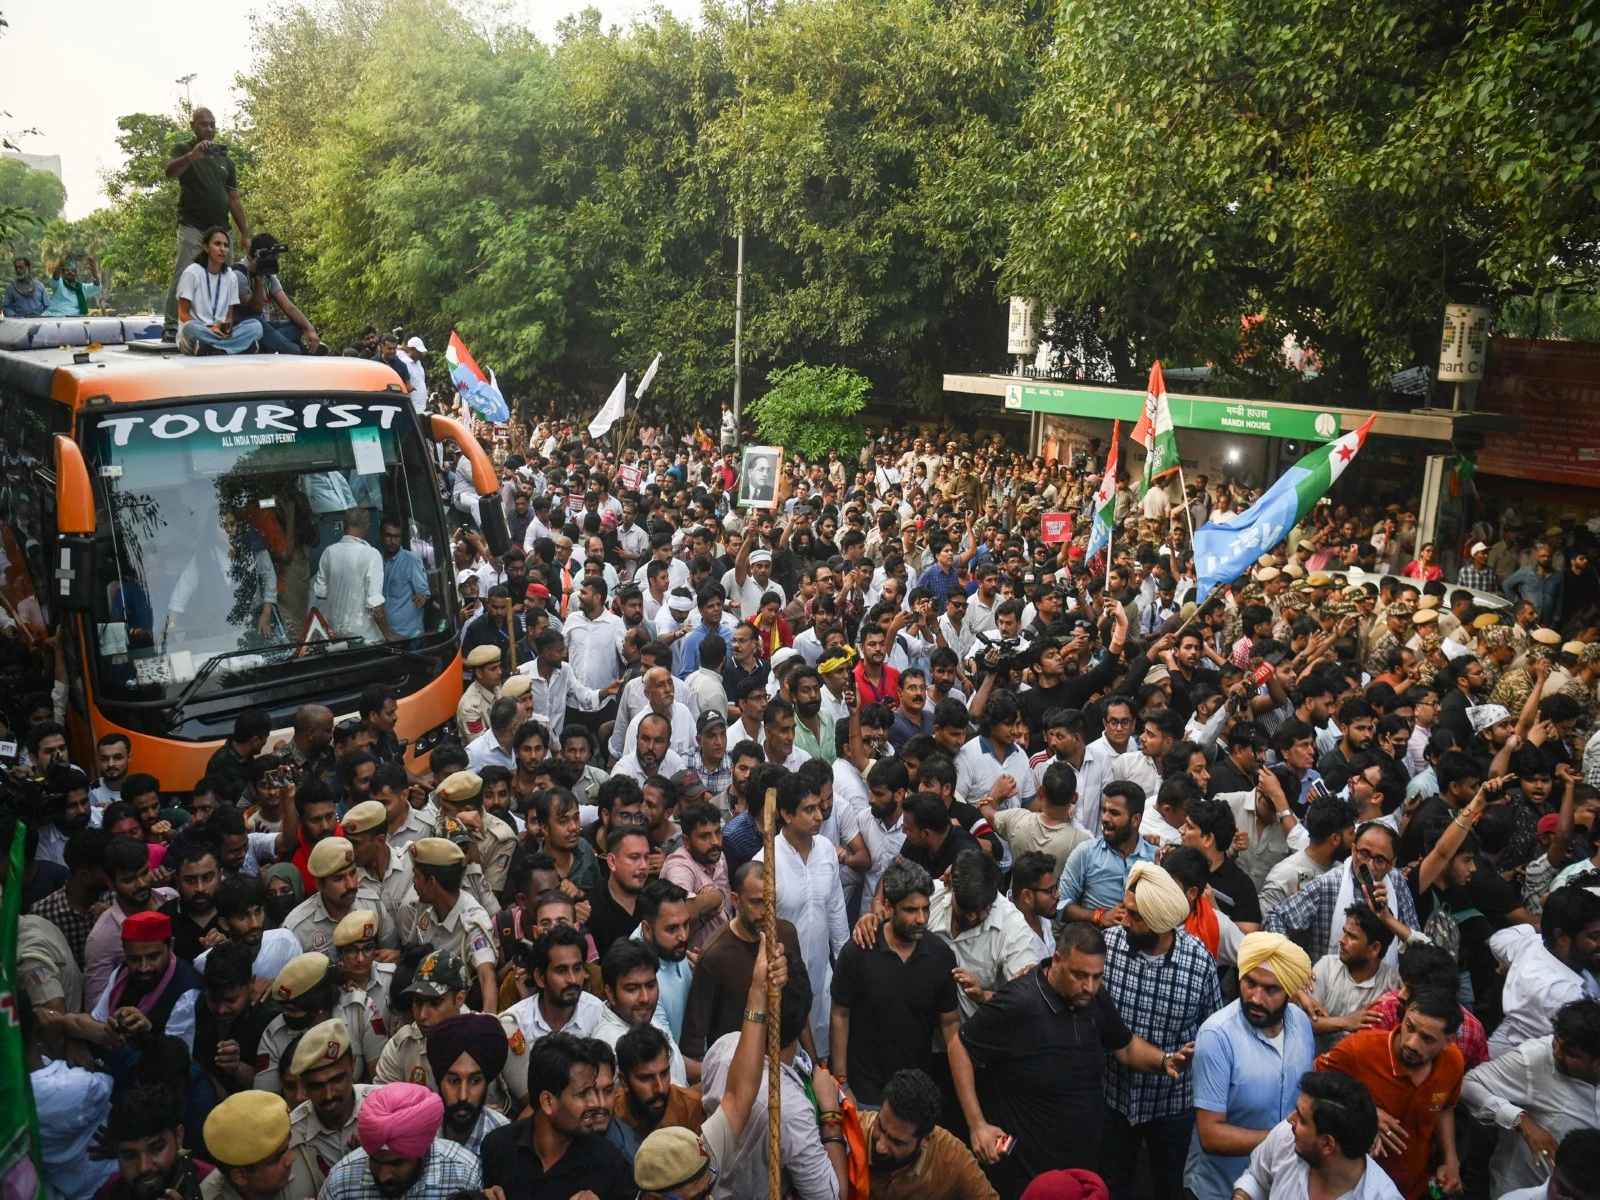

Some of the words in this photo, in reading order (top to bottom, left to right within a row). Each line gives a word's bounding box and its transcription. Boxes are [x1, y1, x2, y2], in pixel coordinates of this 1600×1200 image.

[1053, 389, 1065, 397] LTD
[1225, 404, 1245, 417] मण्डी
[1246, 407, 1269, 419] हाउस
[97, 403, 402, 446] TOURIST
[1221, 417, 1245, 429] MANDI
[1245, 420, 1272, 431] HOUSE
[222, 436, 234, 447] ALL
[233, 434, 250, 446] INDIA
[249, 433, 276, 445] TOURIST
[275, 432, 296, 444] PERMIT
